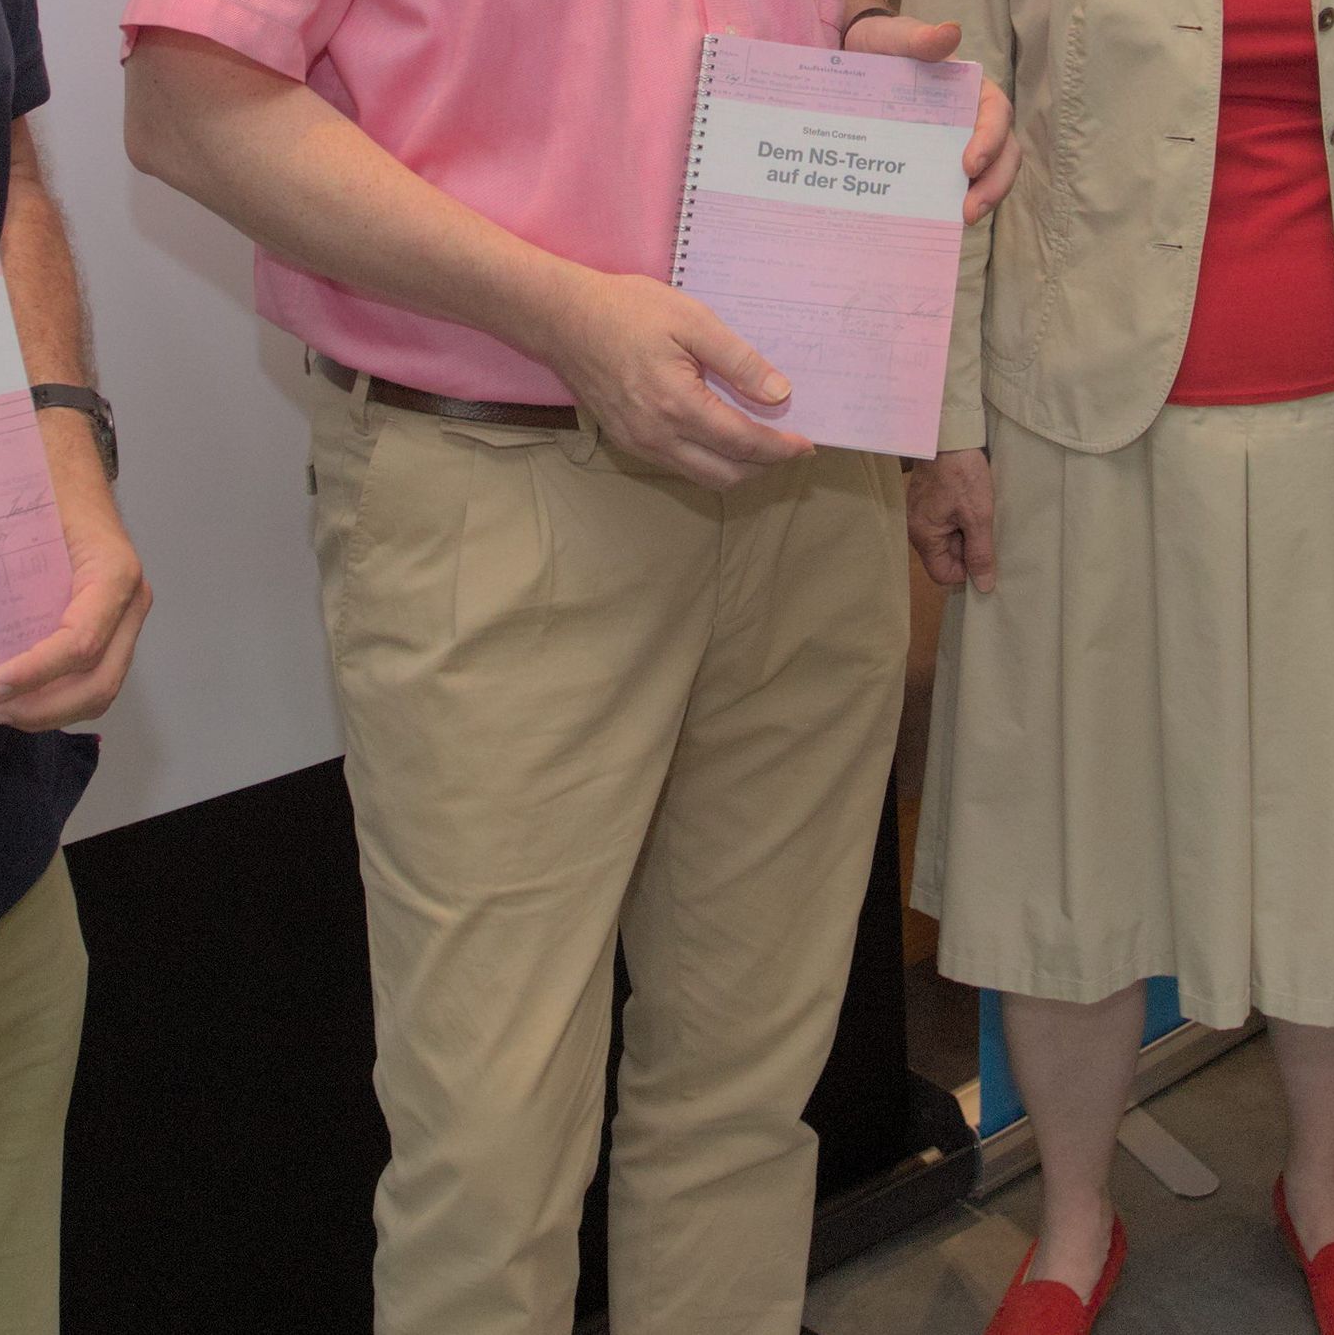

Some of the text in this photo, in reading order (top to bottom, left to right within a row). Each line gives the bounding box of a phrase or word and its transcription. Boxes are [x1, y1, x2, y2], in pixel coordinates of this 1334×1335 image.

[802, 126, 867, 142] Stefan Corssen
[757, 140, 906, 174] Dem NS-Terror
[766, 168, 891, 196] auf der Spur
